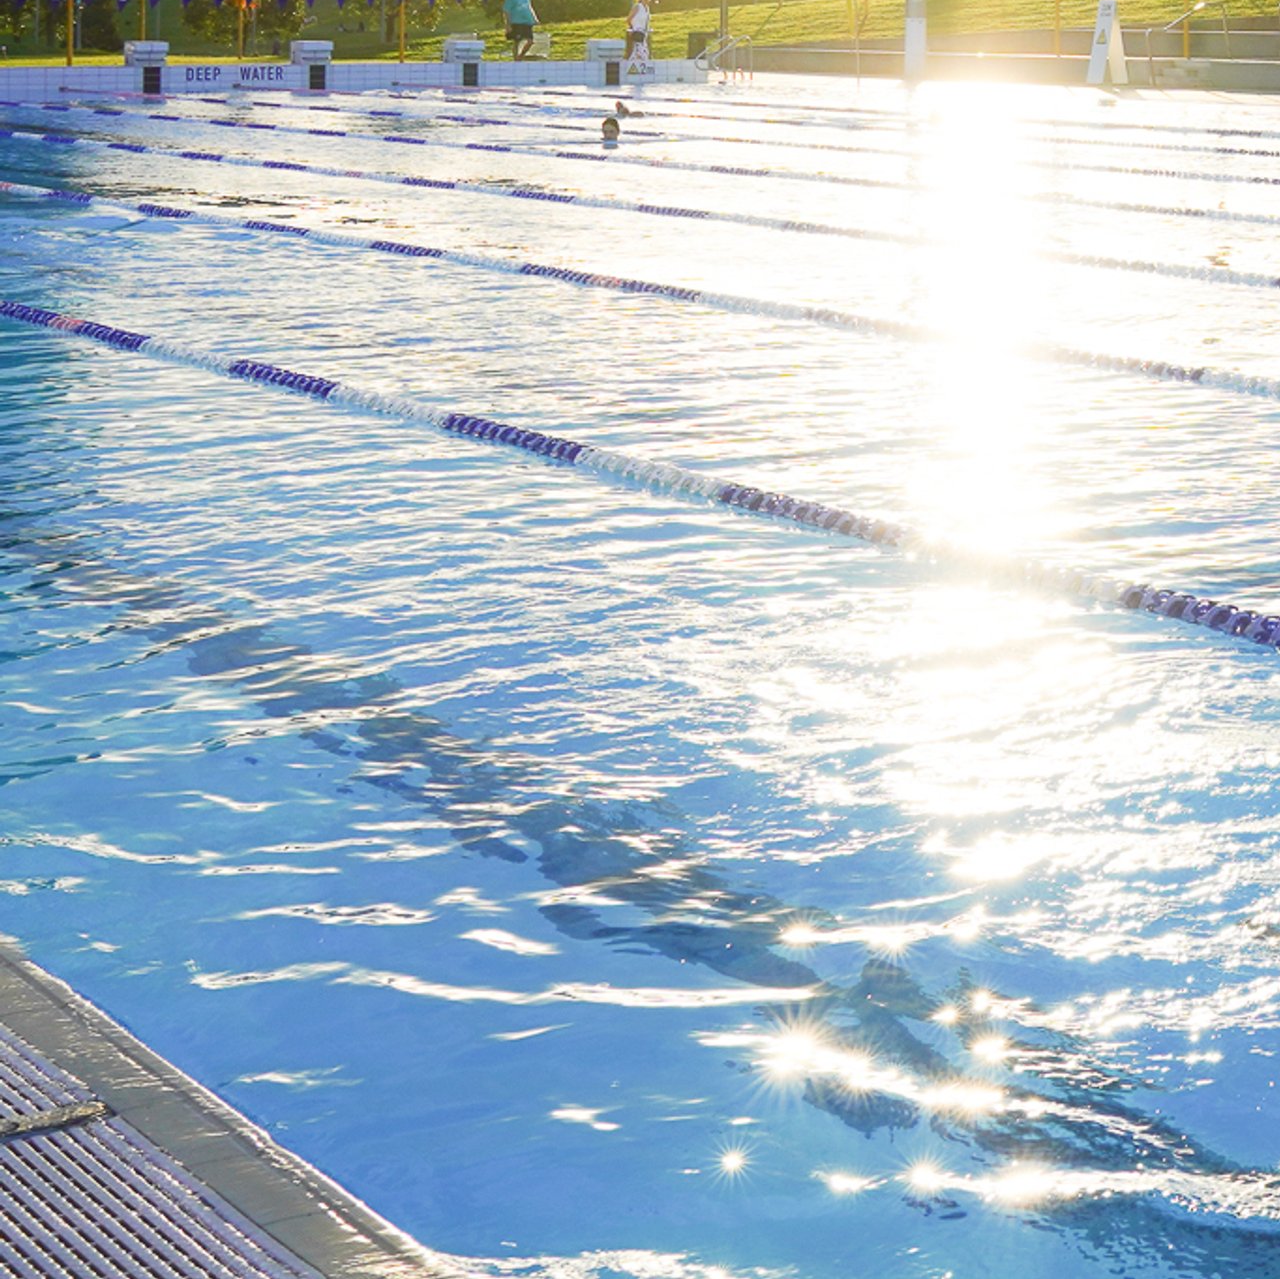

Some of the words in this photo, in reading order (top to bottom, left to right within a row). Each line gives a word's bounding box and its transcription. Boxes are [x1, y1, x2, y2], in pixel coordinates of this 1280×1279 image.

[186, 67, 220, 81] DEEP
[240, 66, 283, 81] WATER
[640, 62, 655, 75] 2m
